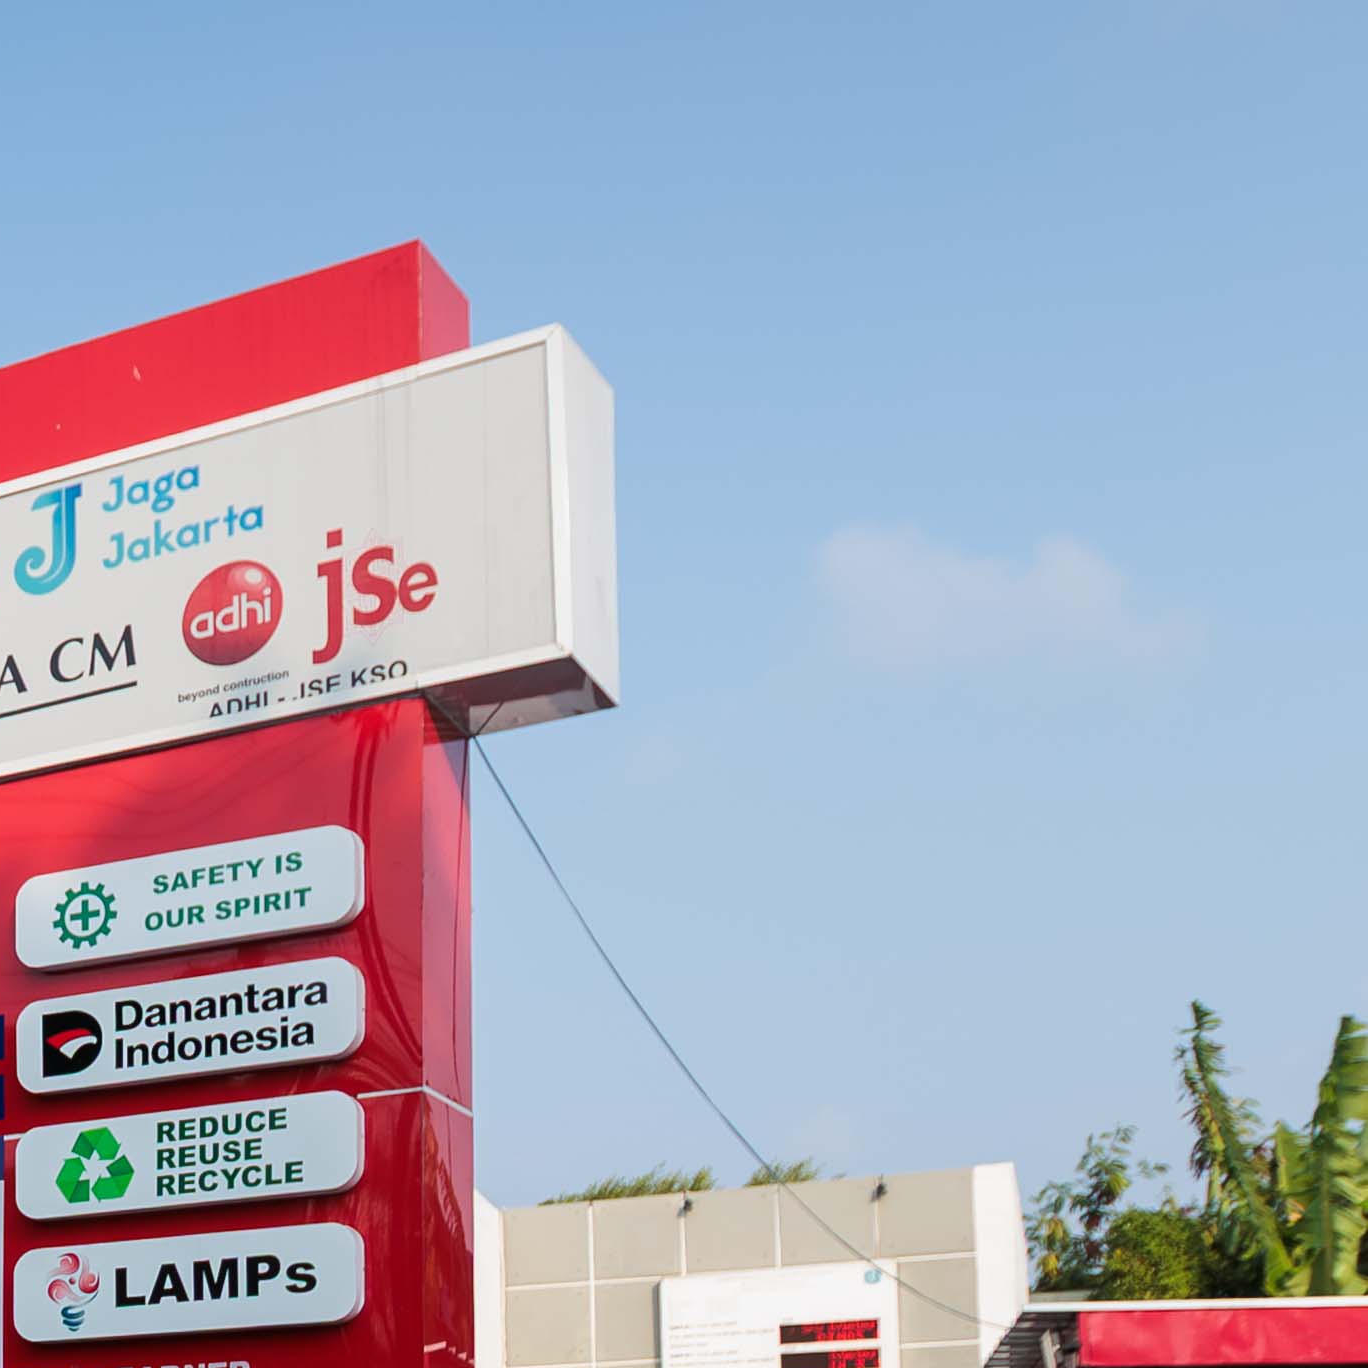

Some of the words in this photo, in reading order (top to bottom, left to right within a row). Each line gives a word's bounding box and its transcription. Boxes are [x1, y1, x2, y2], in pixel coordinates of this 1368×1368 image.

[102, 464, 200, 514] Jaga
[102, 504, 264, 569] Jakarta
[189, 588, 272, 639] adhi
[50, 625, 137, 683] CM
[177, 686, 220, 704] beyond
[223, 669, 290, 692] contruction
[152, 856, 265, 895] SAFETY
[275, 850, 304, 873] IS
[145, 904, 205, 932] OUR
[214, 887, 312, 921] SPIRIT
[114, 980, 329, 1033] Danantara
[114, 1016, 315, 1070] Indonesia
[156, 1107, 288, 1143] REDUCE
[156, 1138, 263, 1170] REUSE
[156, 1160, 304, 1197] RECYCLE
[114, 1253, 318, 1308] LAMPs
